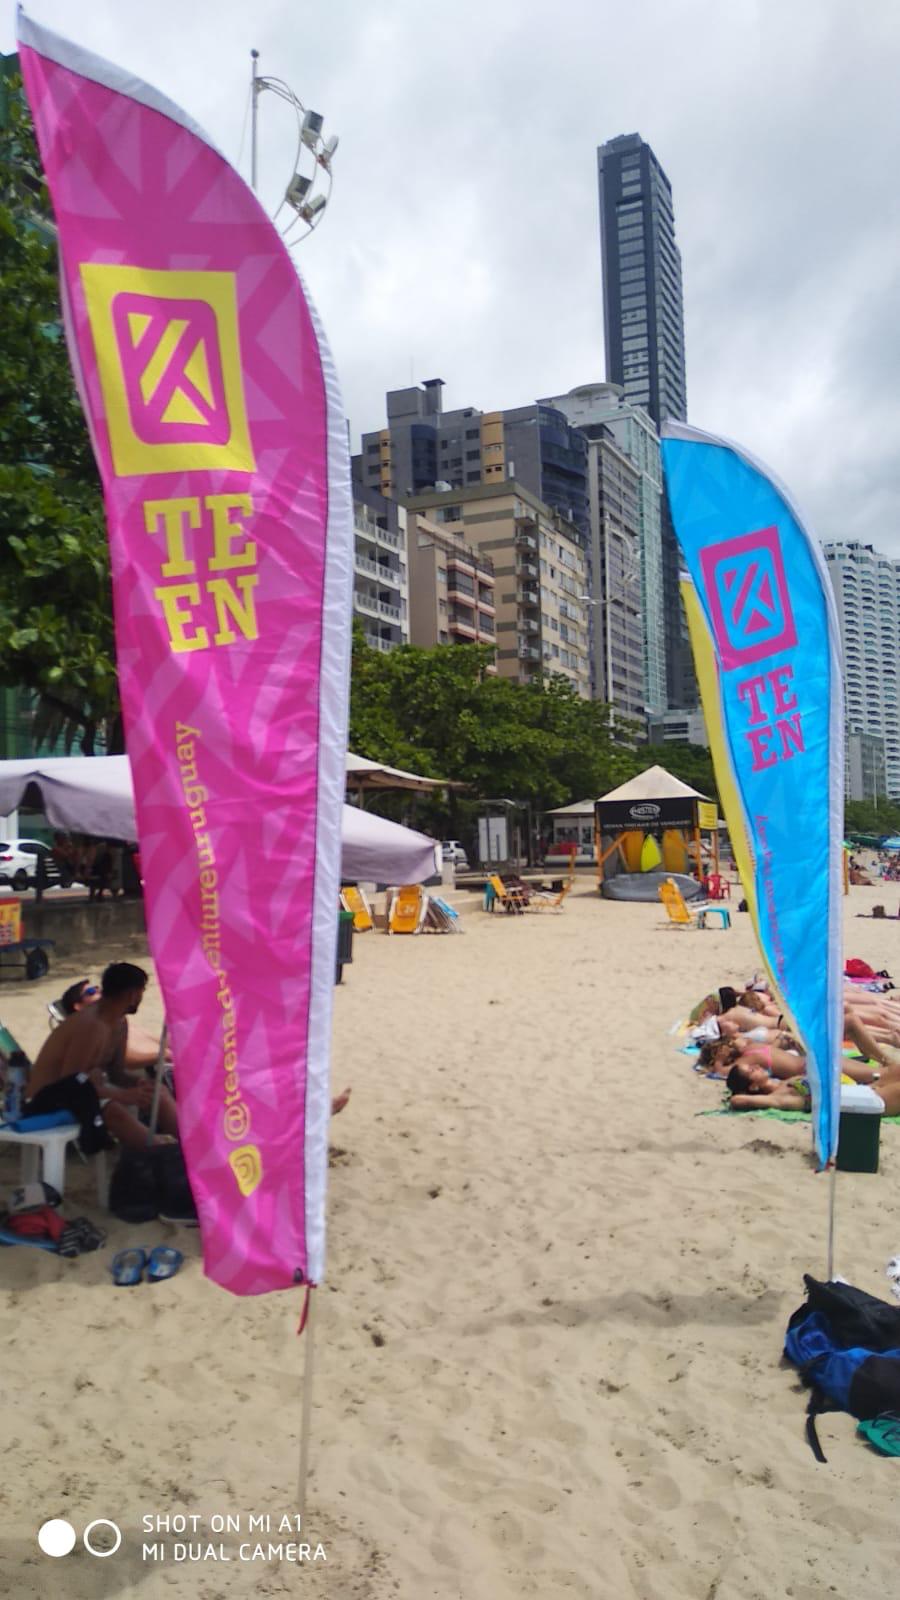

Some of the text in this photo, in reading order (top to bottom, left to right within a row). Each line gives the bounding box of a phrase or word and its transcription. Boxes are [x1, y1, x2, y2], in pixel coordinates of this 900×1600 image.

[144, 493, 257, 577] TE
[155, 574, 260, 653] EN
[738, 664, 798, 725] TE
[746, 712, 806, 772] EN
